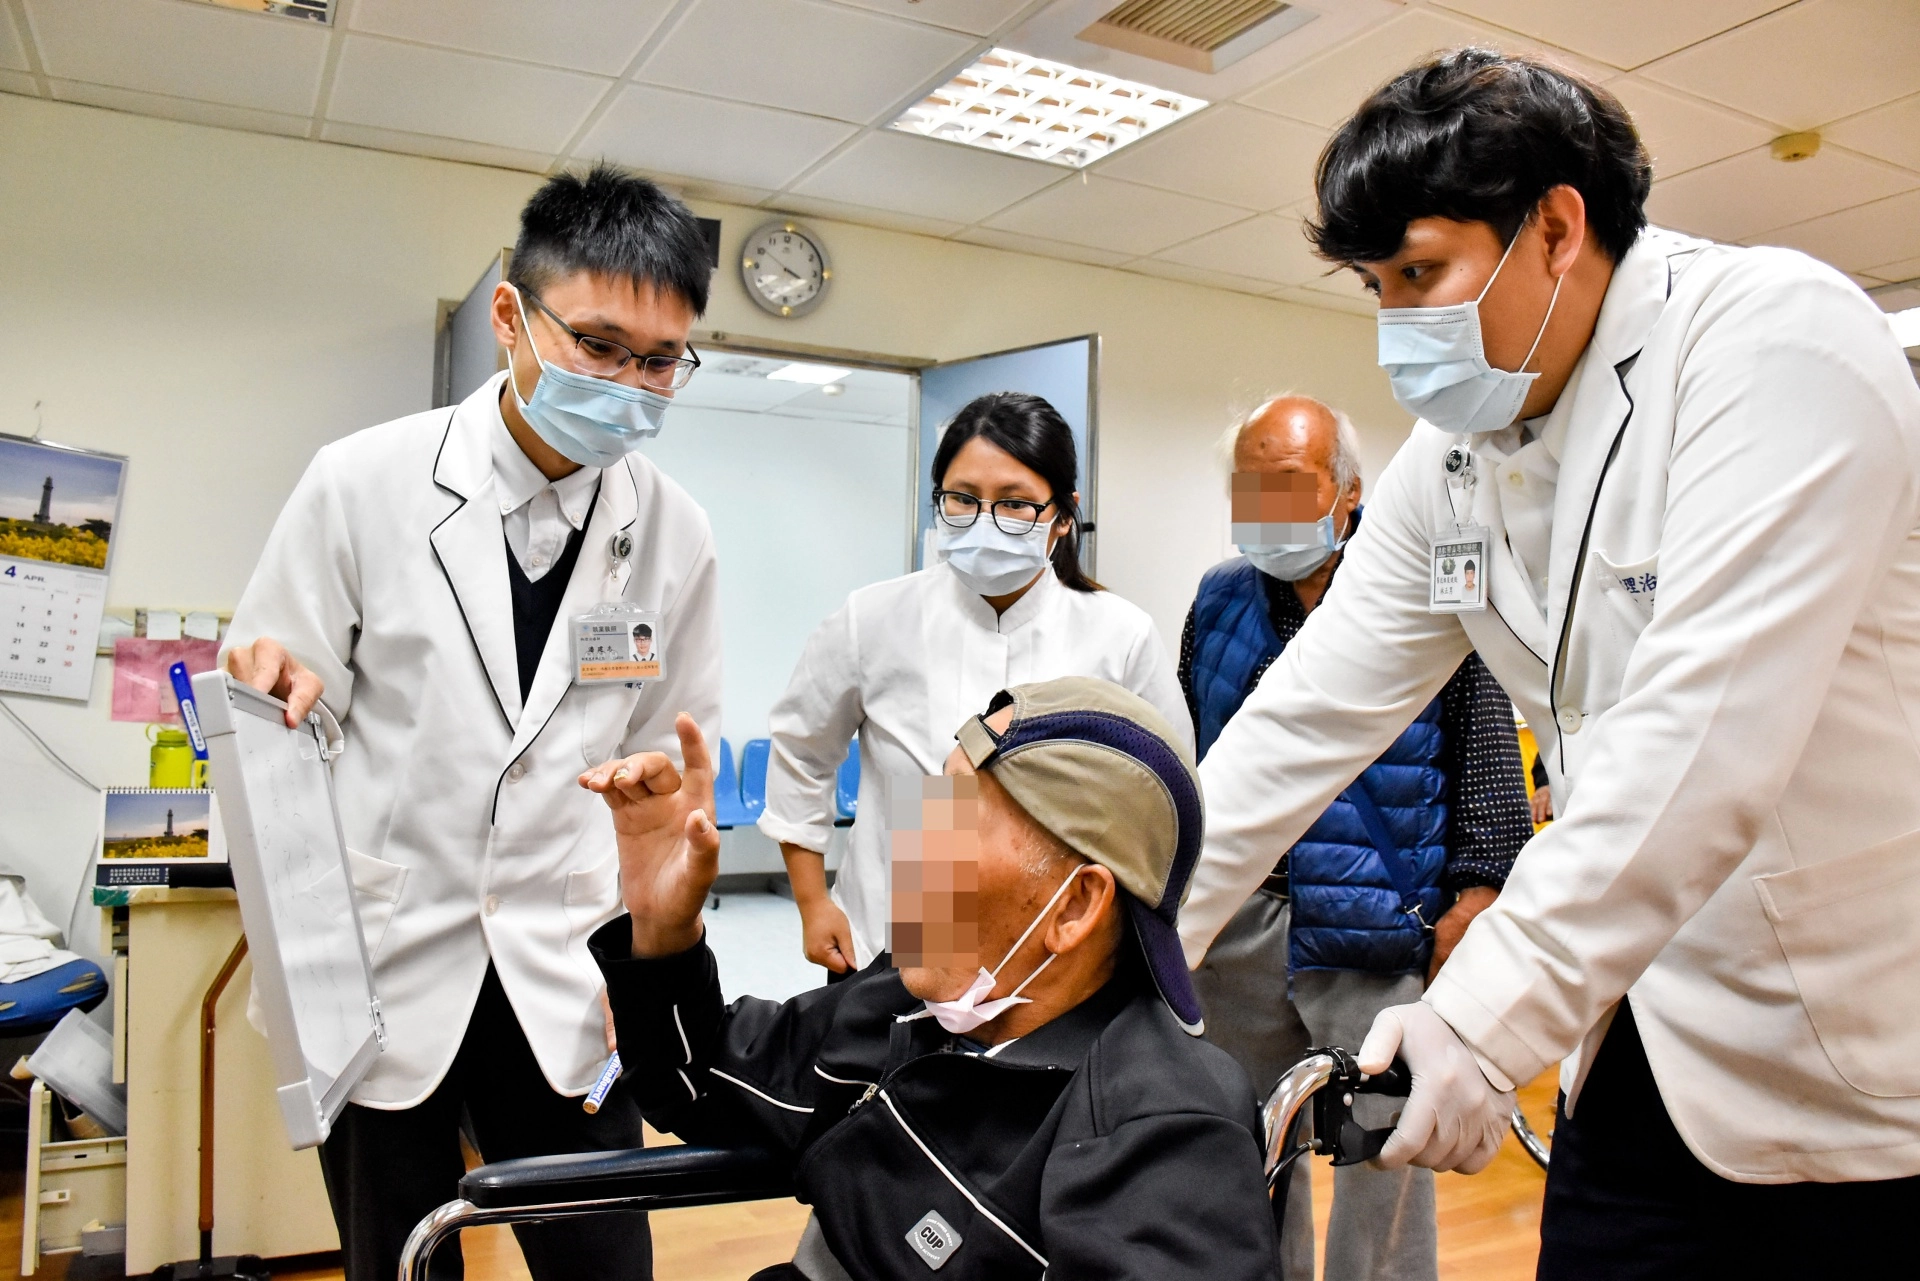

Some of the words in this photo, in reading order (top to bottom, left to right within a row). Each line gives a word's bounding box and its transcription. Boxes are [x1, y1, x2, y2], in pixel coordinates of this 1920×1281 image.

[768, 237, 776, 246] 11
[5, 565, 16, 578] 4
[1615, 573, 1657, 593] 理治
[920, 1225, 945, 1250] CUP
